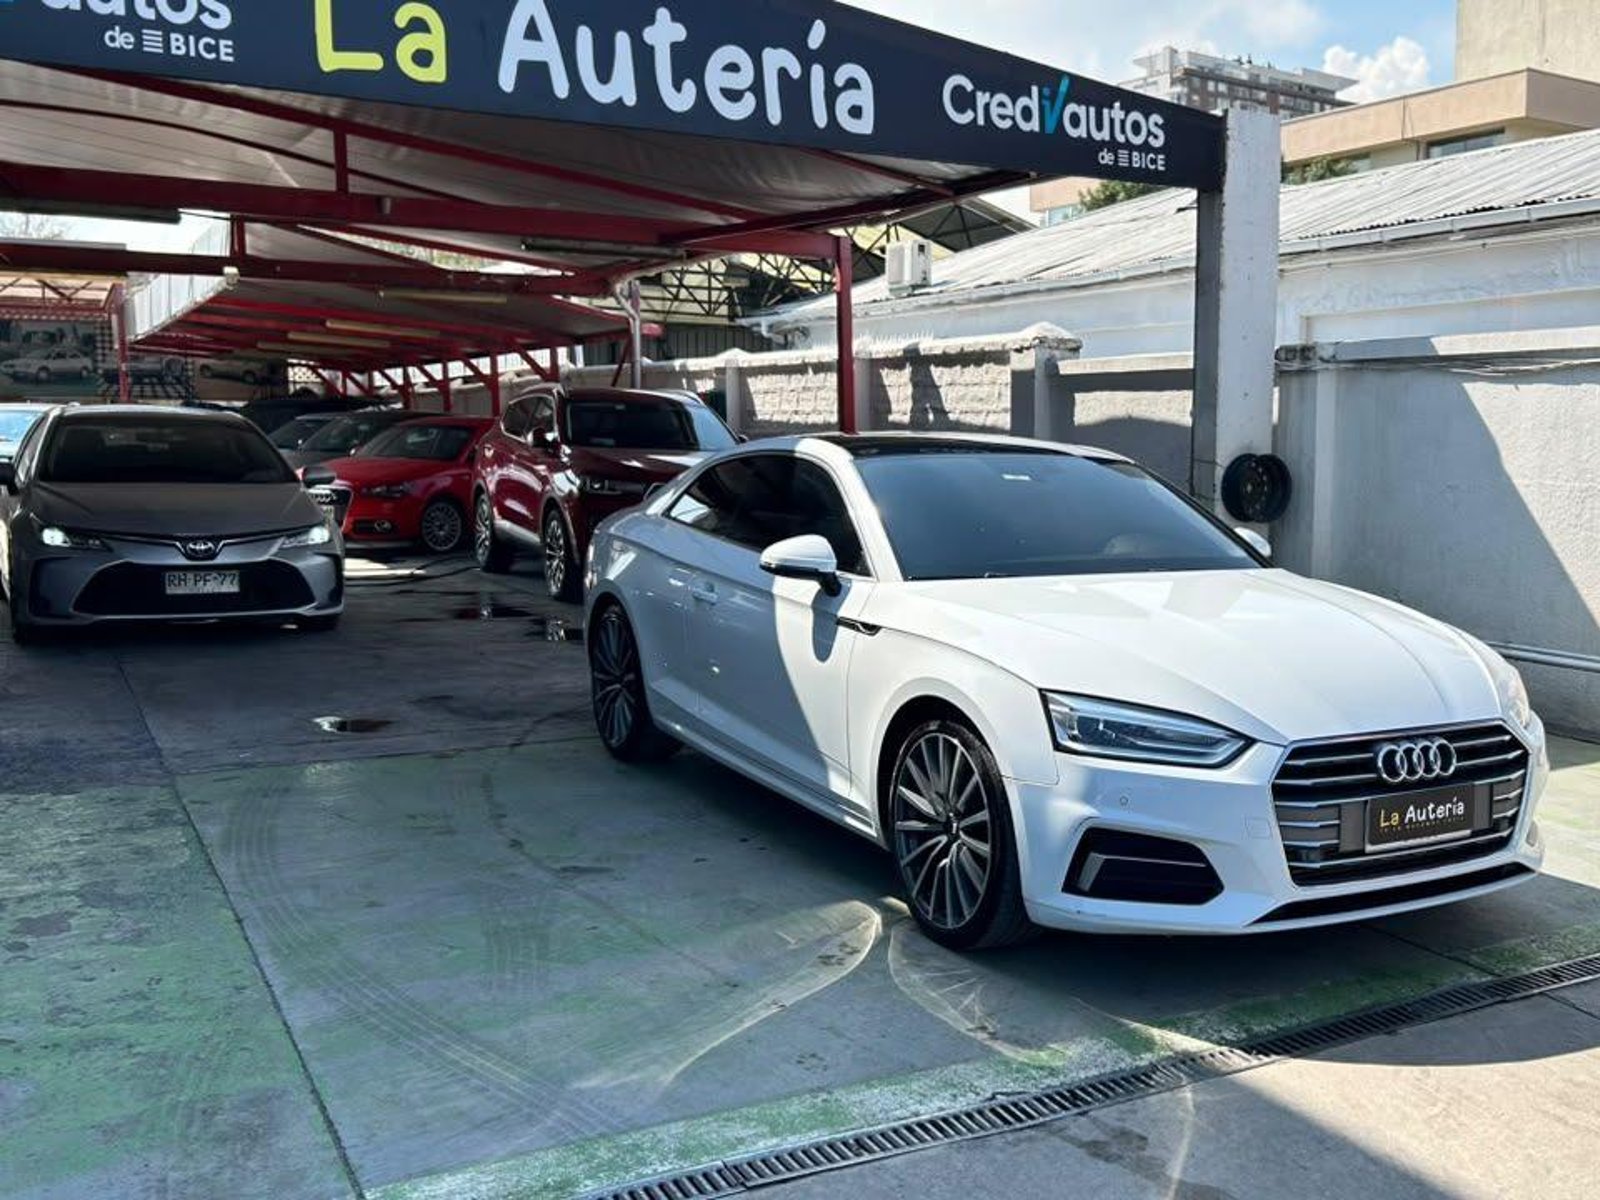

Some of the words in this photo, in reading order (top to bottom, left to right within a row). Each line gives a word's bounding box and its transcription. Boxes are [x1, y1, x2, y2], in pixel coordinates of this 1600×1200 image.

[104, 25, 135, 50] de
[169, 33, 235, 62] BICE
[314, 0, 447, 84] La
[497, 0, 875, 135] Autería
[1098, 148, 1115, 166] de
[1131, 151, 1166, 171] BICE
[1380, 808, 1400, 828] La
[1404, 796, 1465, 824] Autería
